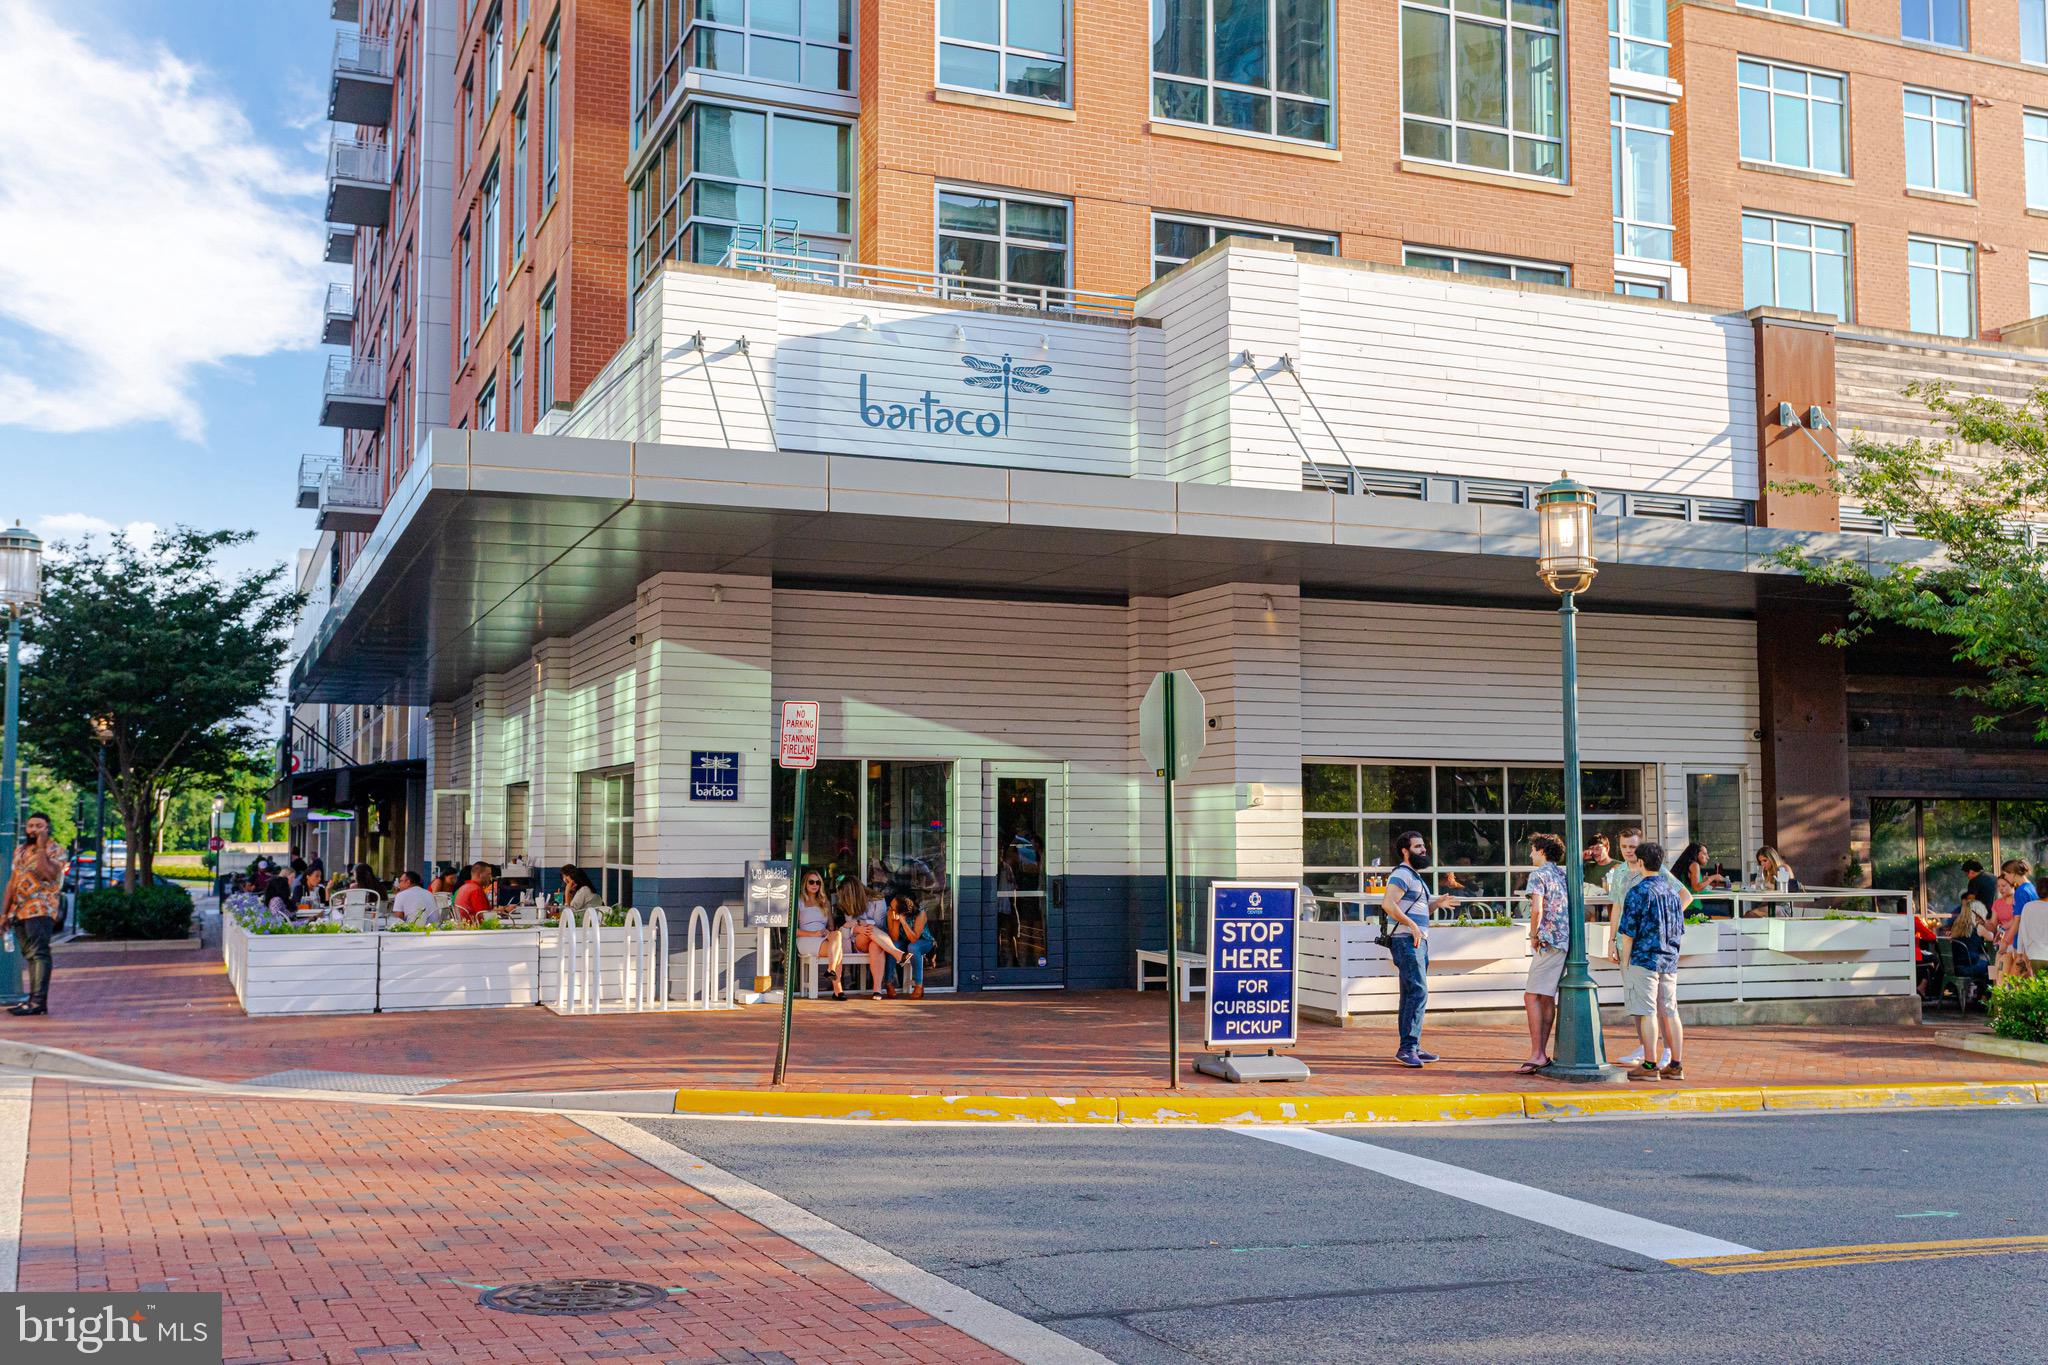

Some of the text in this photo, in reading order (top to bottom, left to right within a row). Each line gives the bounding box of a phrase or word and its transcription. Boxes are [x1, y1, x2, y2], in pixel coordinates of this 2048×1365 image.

[860, 373, 1000, 437] bartaco
[796, 709, 806, 718] NO
[786, 719, 814, 729] PARKING
[784, 734, 815, 743] STANDING
[783, 744, 814, 755] FIRELANE
[696, 781, 734, 797] bartaco
[769, 914, 782, 924] 600
[1222, 922, 1284, 942] STOP
[1222, 948, 1283, 969] HERE
[1237, 979, 1269, 993] FOR
[1213, 999, 1290, 1014] CURBSIDE
[1226, 1019, 1282, 1034] PICKUP
